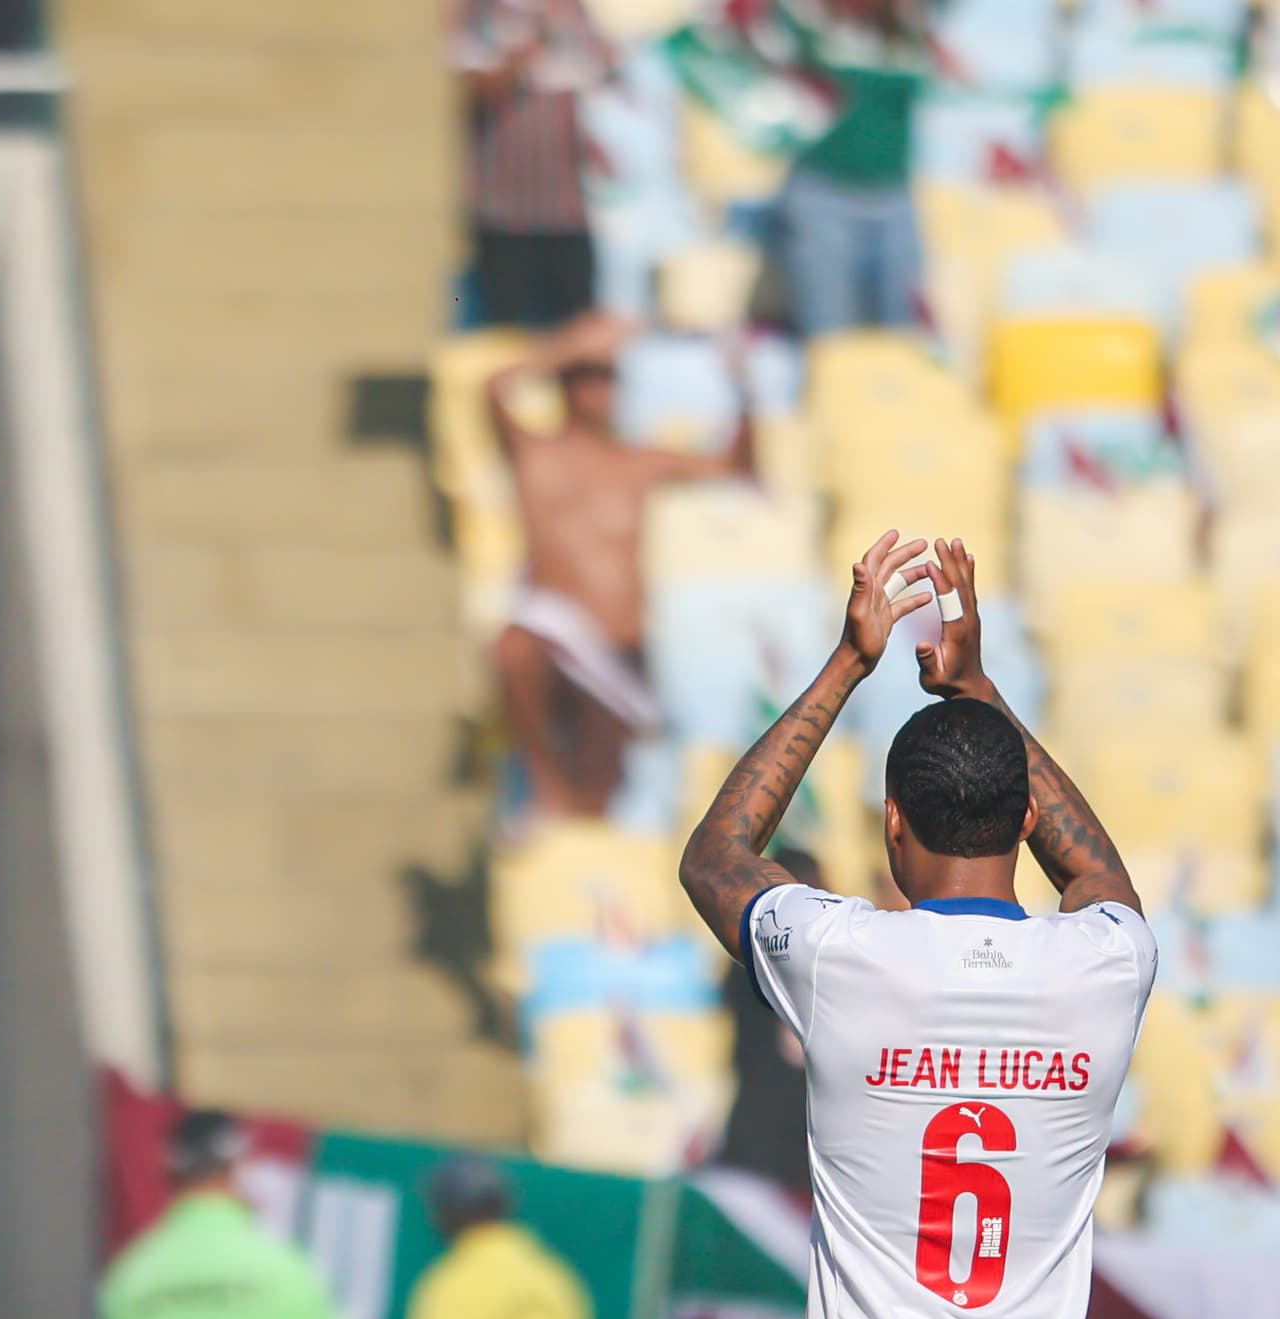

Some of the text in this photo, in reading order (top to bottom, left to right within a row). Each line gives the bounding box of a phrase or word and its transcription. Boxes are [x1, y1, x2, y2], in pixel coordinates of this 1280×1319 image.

[865, 1047, 1091, 1092] JEAN LUCAS
[915, 1100, 1017, 1310] 6
